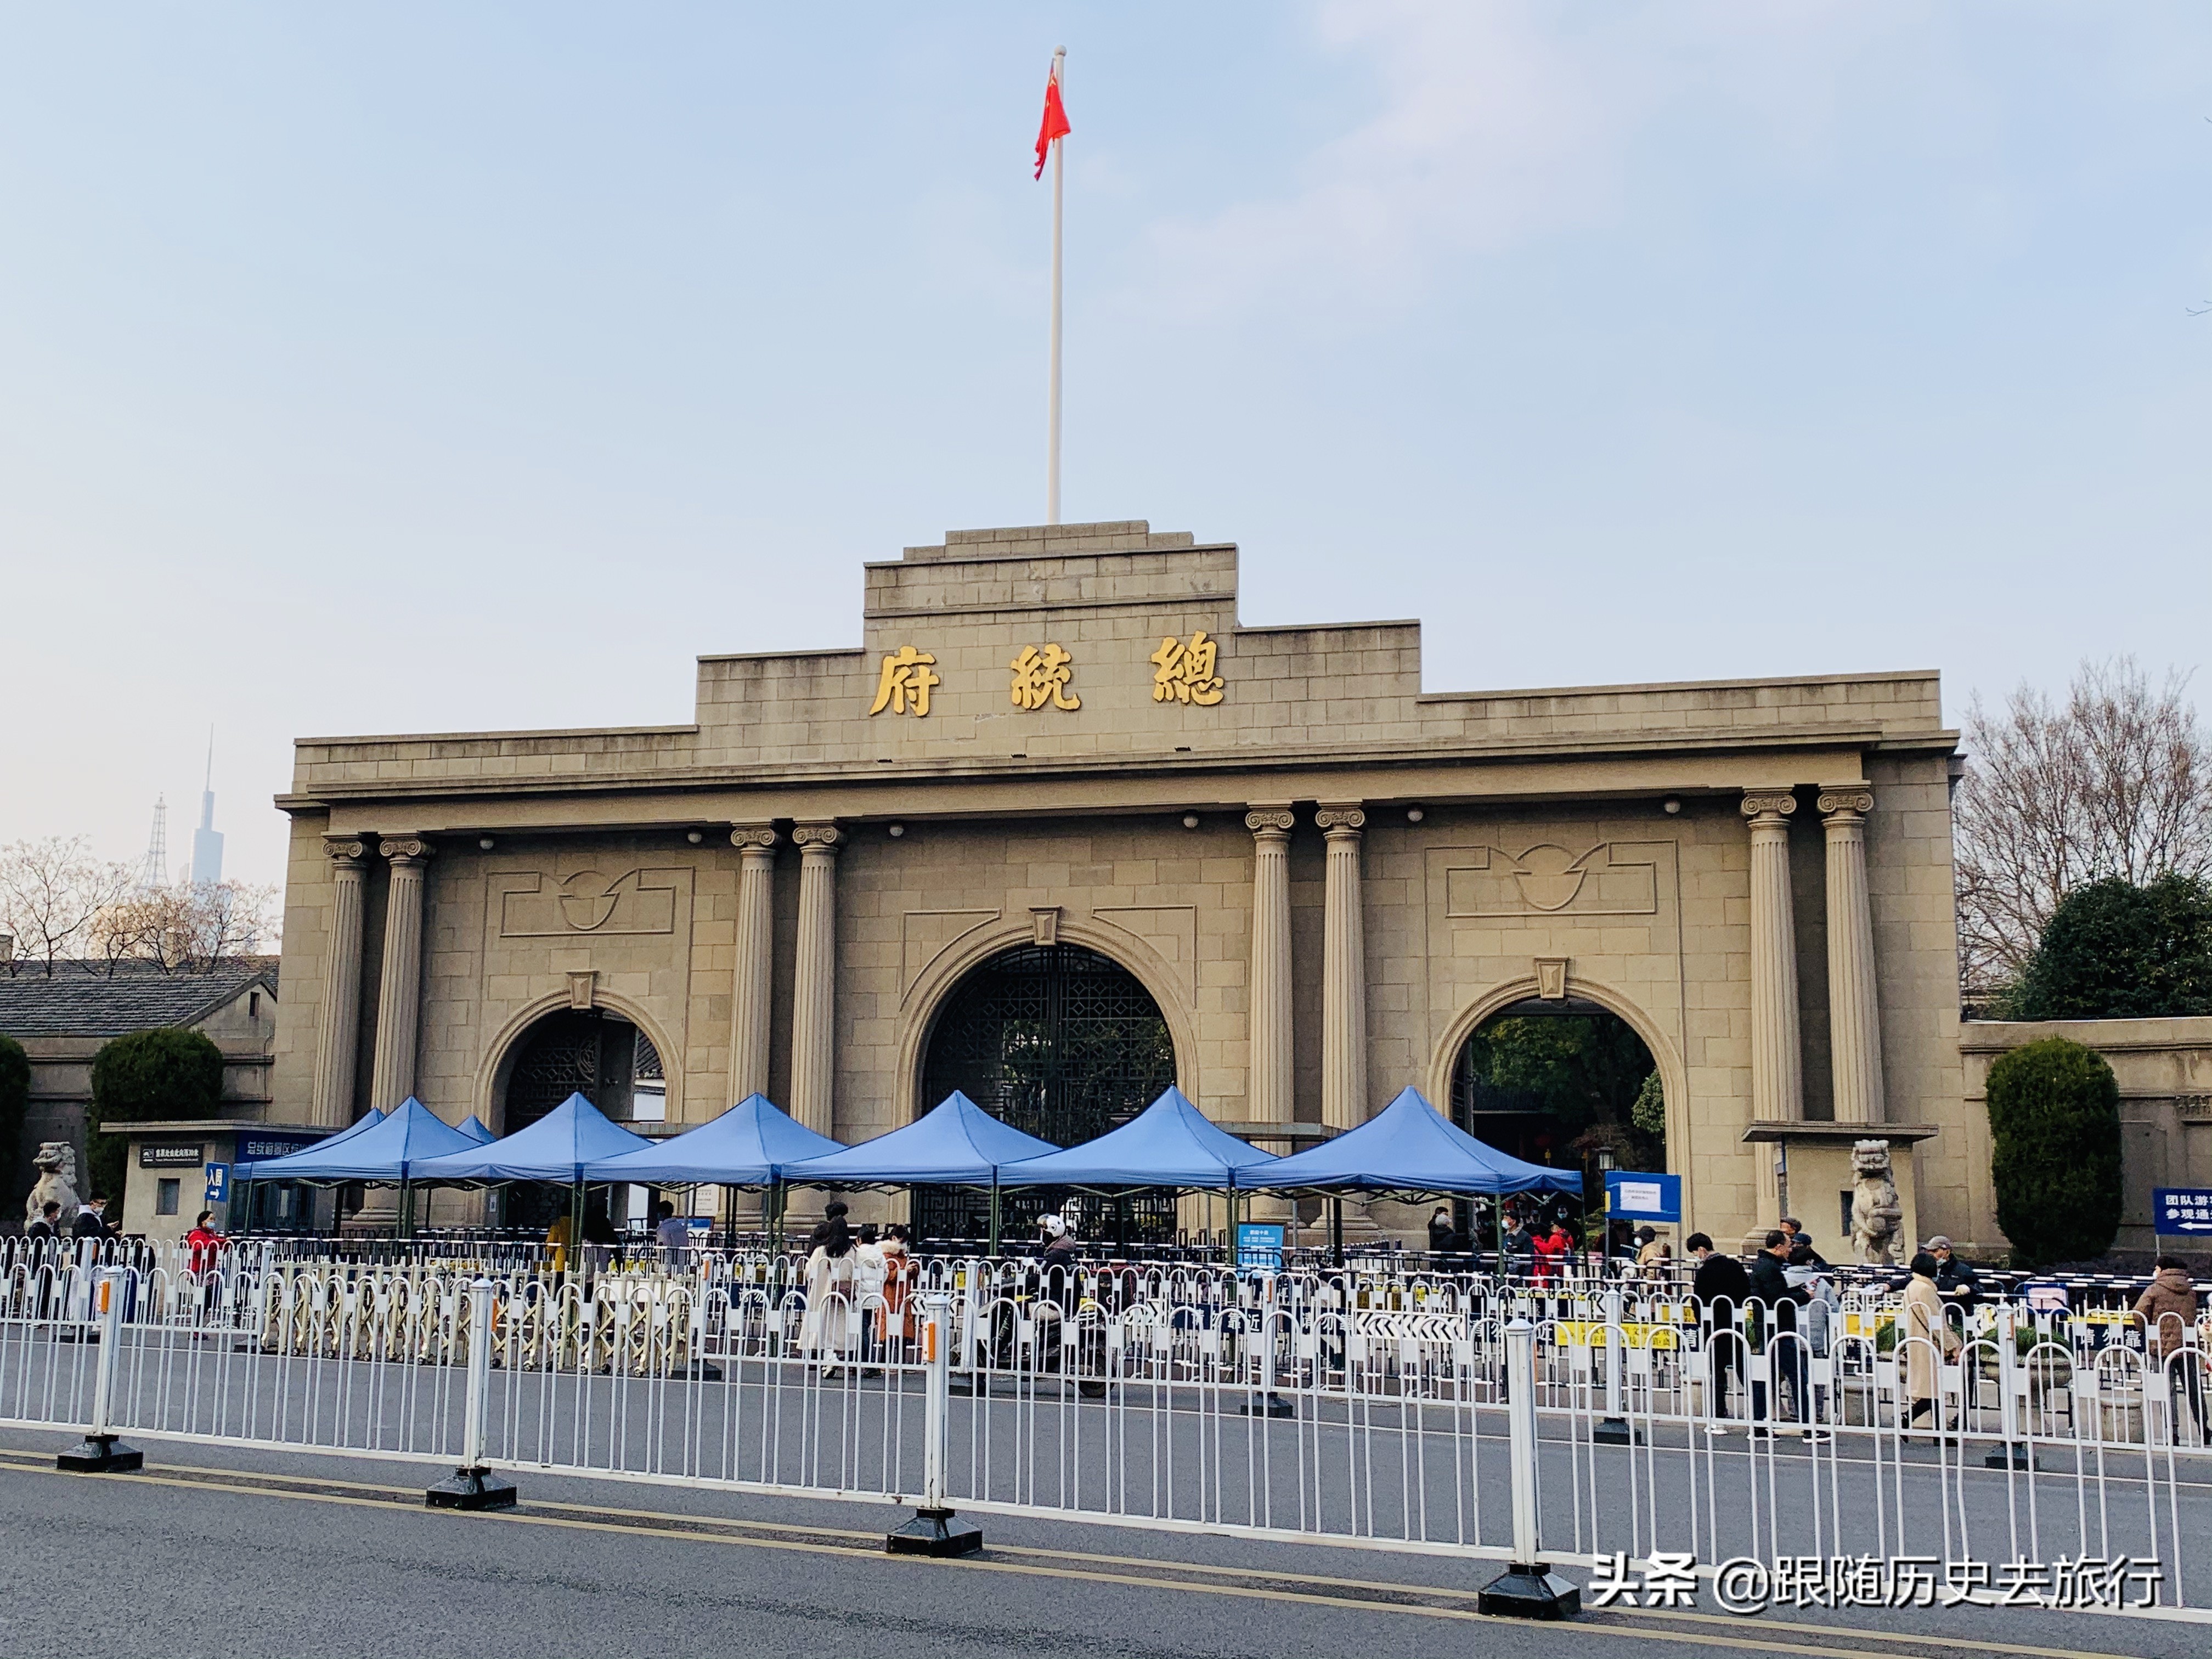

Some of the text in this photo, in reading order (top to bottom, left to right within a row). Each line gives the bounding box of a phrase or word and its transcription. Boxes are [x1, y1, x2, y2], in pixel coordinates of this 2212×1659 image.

[869, 630, 1224, 718] 總統府
[2165, 1195, 2212, 1206] 团队游
[2166, 1208, 2212, 1220] 参观通
